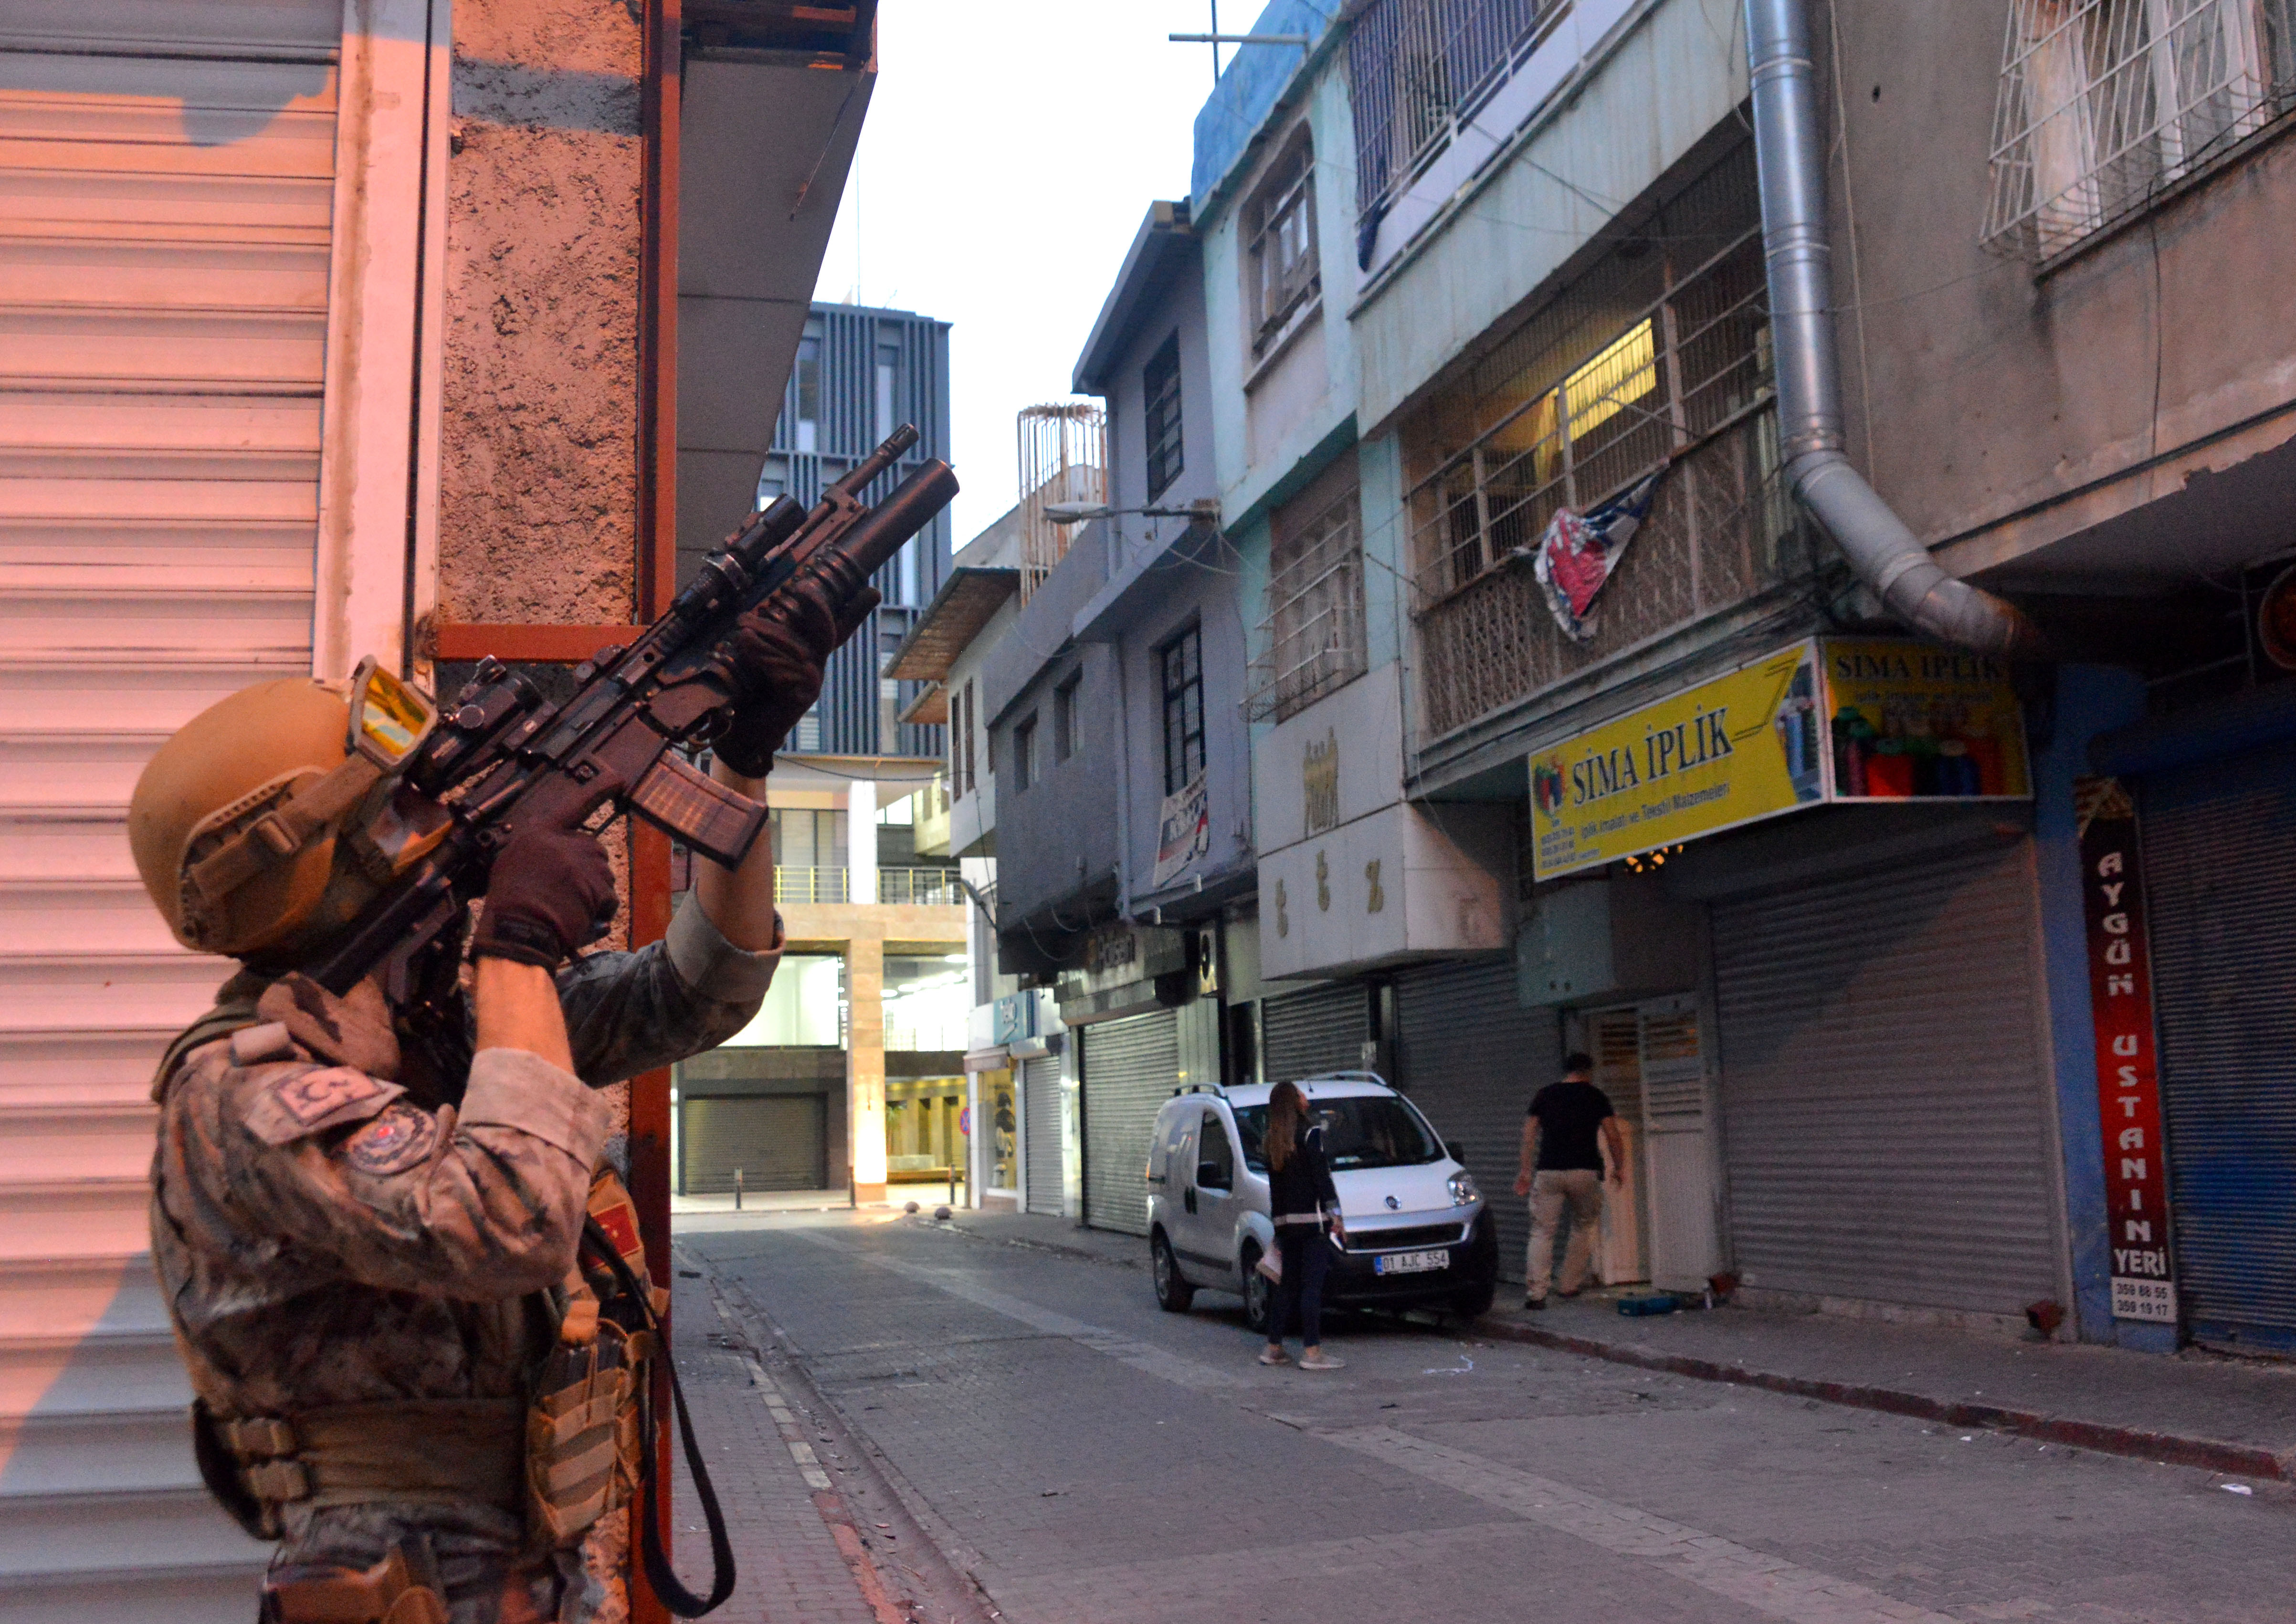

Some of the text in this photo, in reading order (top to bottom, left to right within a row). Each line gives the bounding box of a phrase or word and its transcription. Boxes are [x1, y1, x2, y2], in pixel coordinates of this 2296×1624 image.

[1572, 704, 1734, 807] SİMA İPLİK
[2112, 1035, 2151, 1241] USTANIN
[1383, 1252, 1446, 1269] 01 AJC 554
[2114, 1246, 2166, 1276] YERİ
[2156, 1304, 2168, 1316] 17
